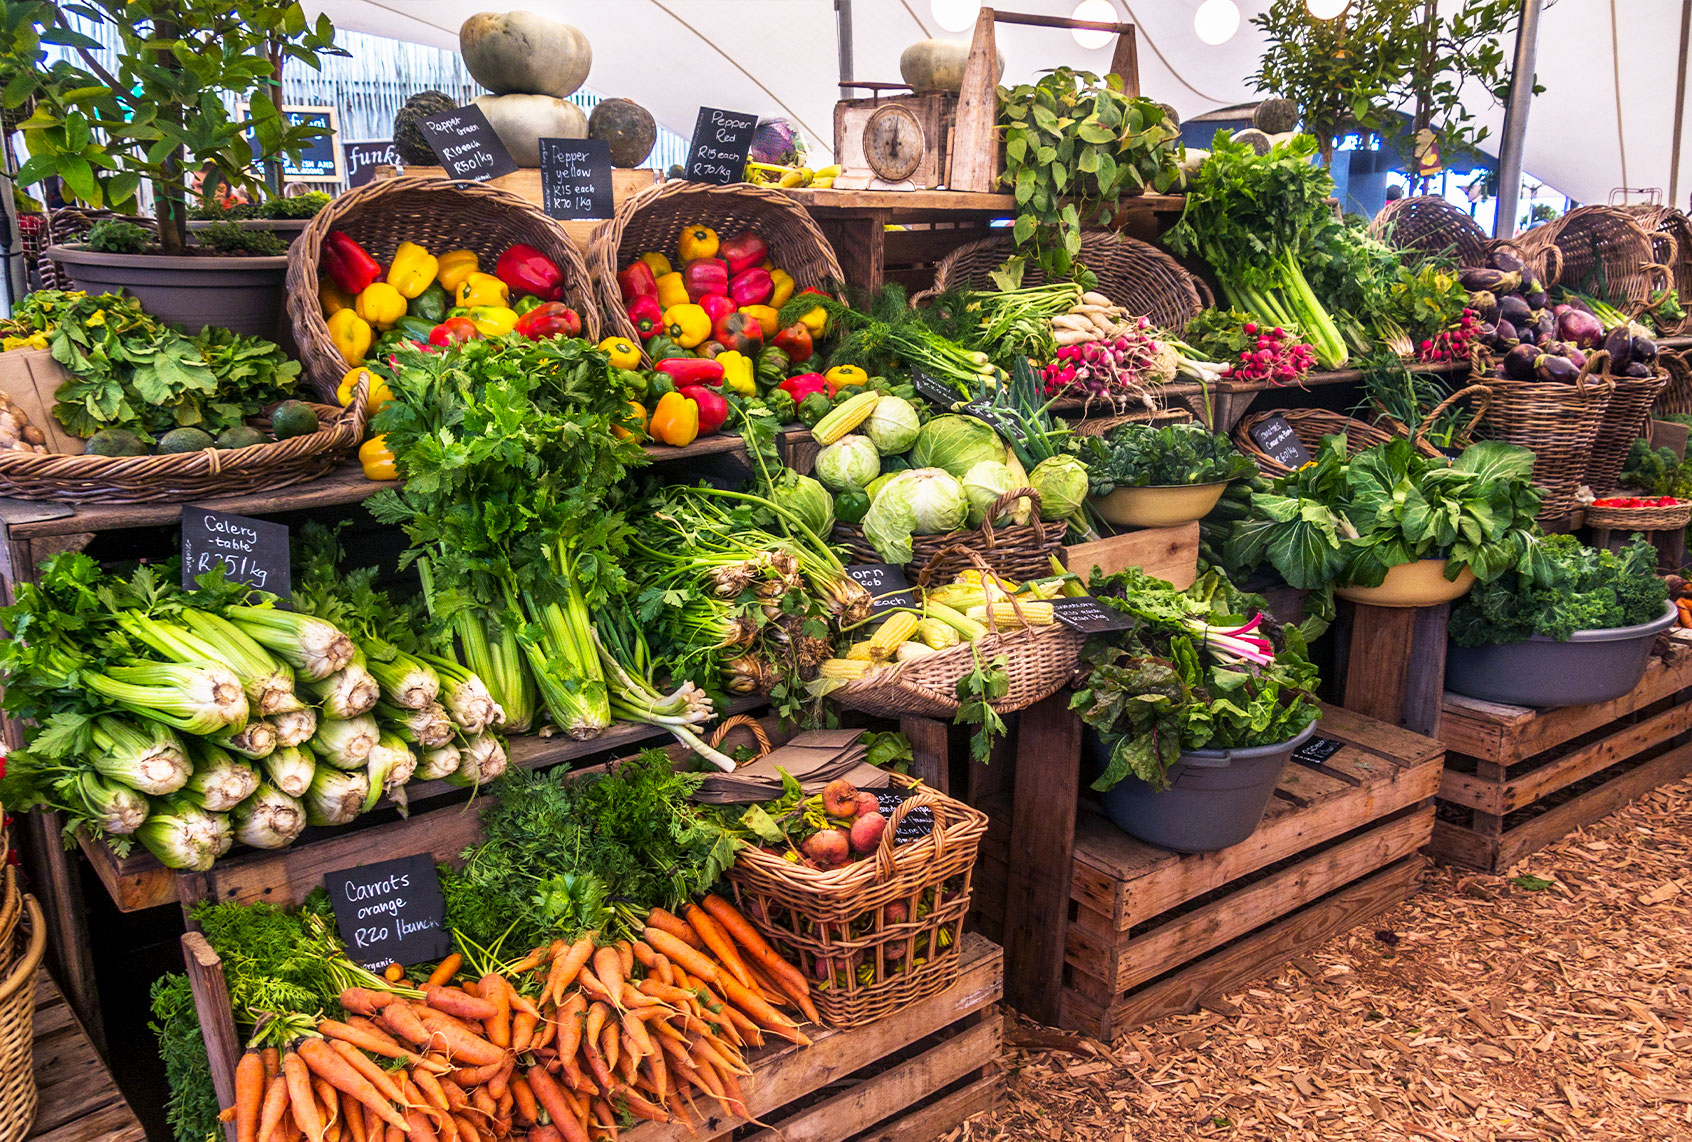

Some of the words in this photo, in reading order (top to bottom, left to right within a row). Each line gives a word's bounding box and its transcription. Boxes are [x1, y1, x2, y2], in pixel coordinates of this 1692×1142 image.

[426, 117, 461, 135] Pepper
[711, 110, 752, 130] Pepper
[716, 128, 736, 143] Red
[552, 145, 590, 167] Pepper
[556, 166, 592, 184] yellow
[574, 184, 595, 193] each
[204, 515, 257, 544] Celery
[844, 567, 884, 579] orn
[861, 577, 882, 587] cob
[873, 596, 907, 607] each
[345, 874, 410, 902] Carrots
[357, 897, 407, 920] orange
[355, 926, 389, 949] R20
